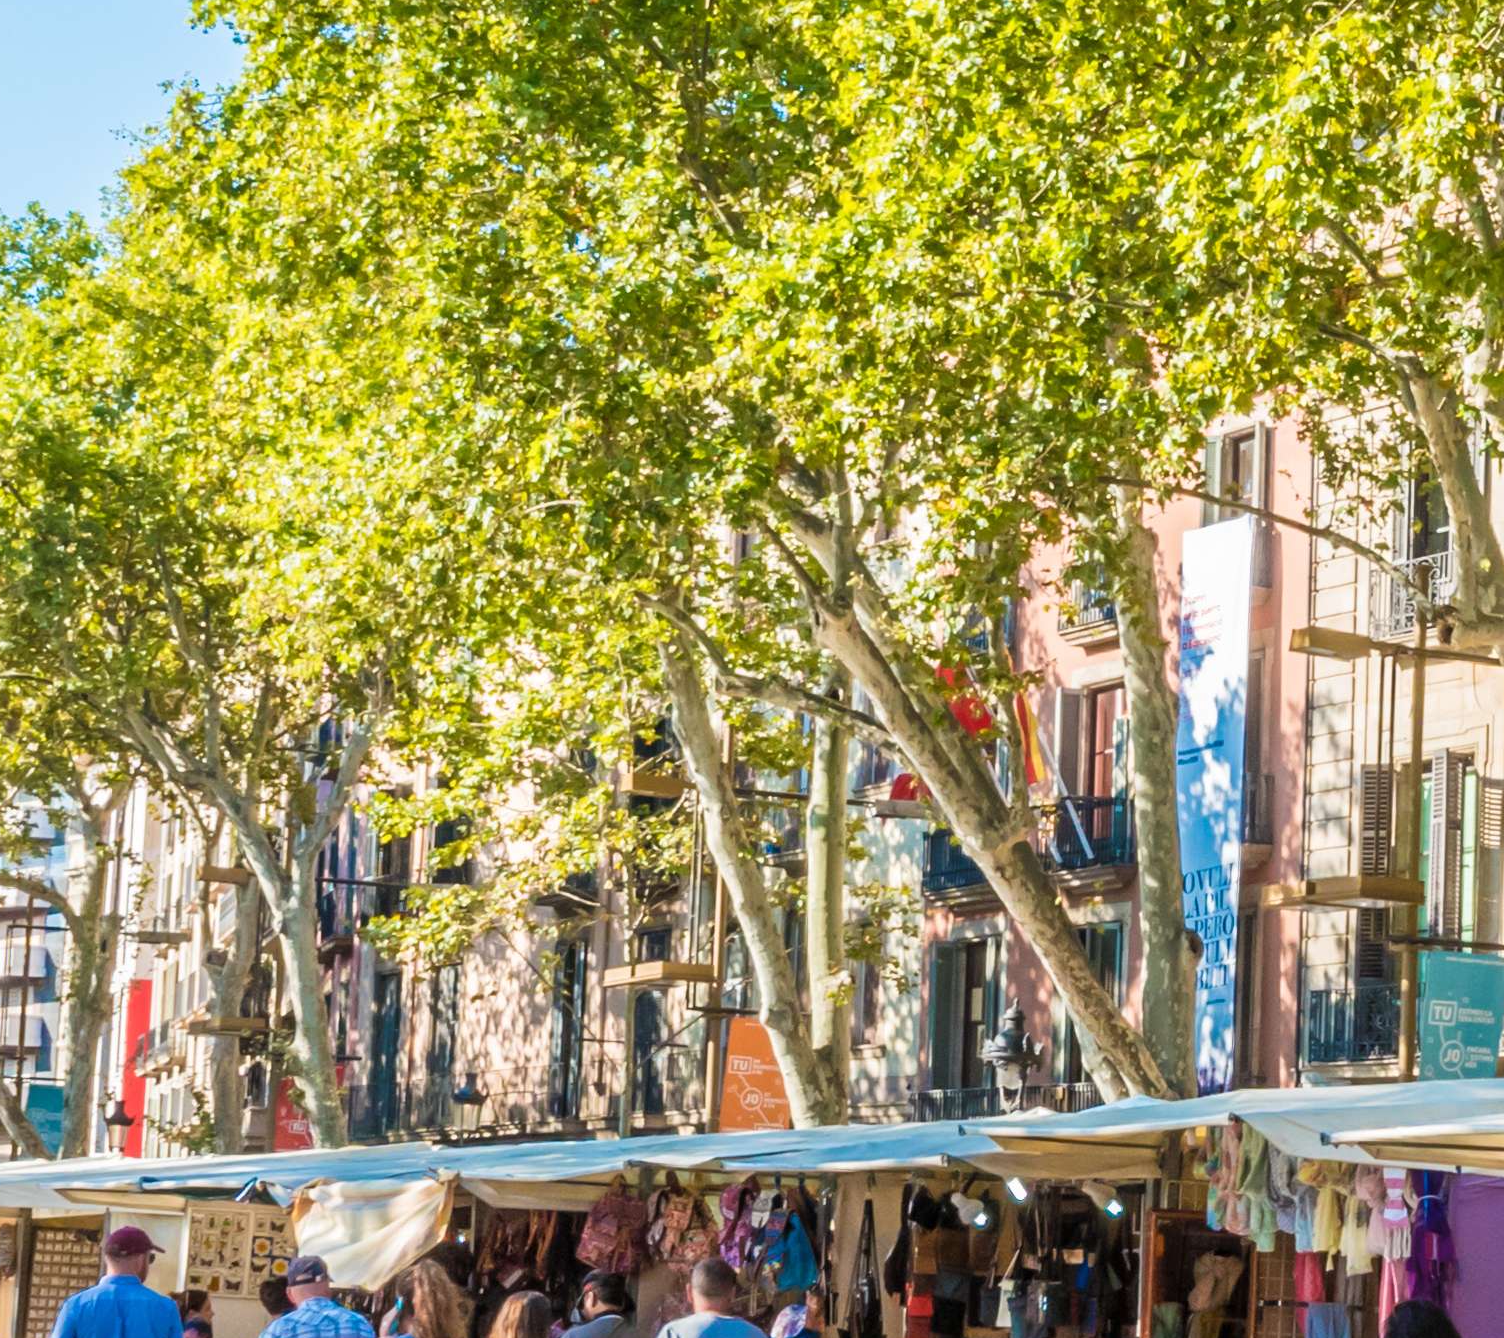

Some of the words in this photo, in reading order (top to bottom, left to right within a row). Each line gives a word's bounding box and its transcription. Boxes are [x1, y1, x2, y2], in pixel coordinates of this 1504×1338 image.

[1434, 1005, 1452, 1021] TU
[1444, 1051, 1460, 1062] JO
[732, 1059, 748, 1071] TU
[745, 1093, 759, 1105] JO
